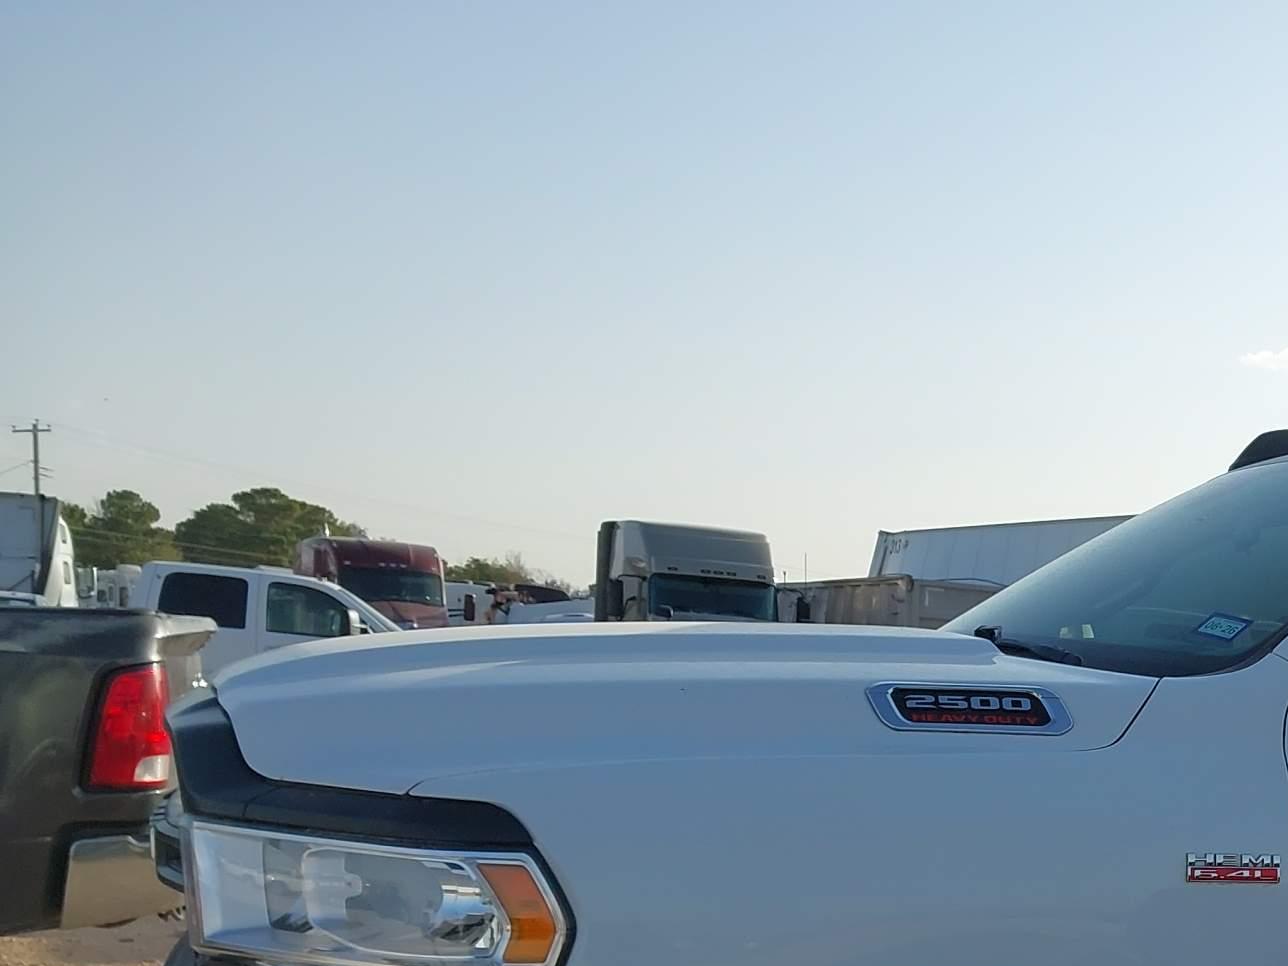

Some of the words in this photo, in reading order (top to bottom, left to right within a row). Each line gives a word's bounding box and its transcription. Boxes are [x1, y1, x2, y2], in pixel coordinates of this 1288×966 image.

[904, 694, 1032, 711] 2500
[911, 713, 979, 723] HEAVY
[983, 715, 1039, 725] DUTY
[1186, 852, 1281, 867] HEMI
[1193, 868, 1275, 881] 6.4L
